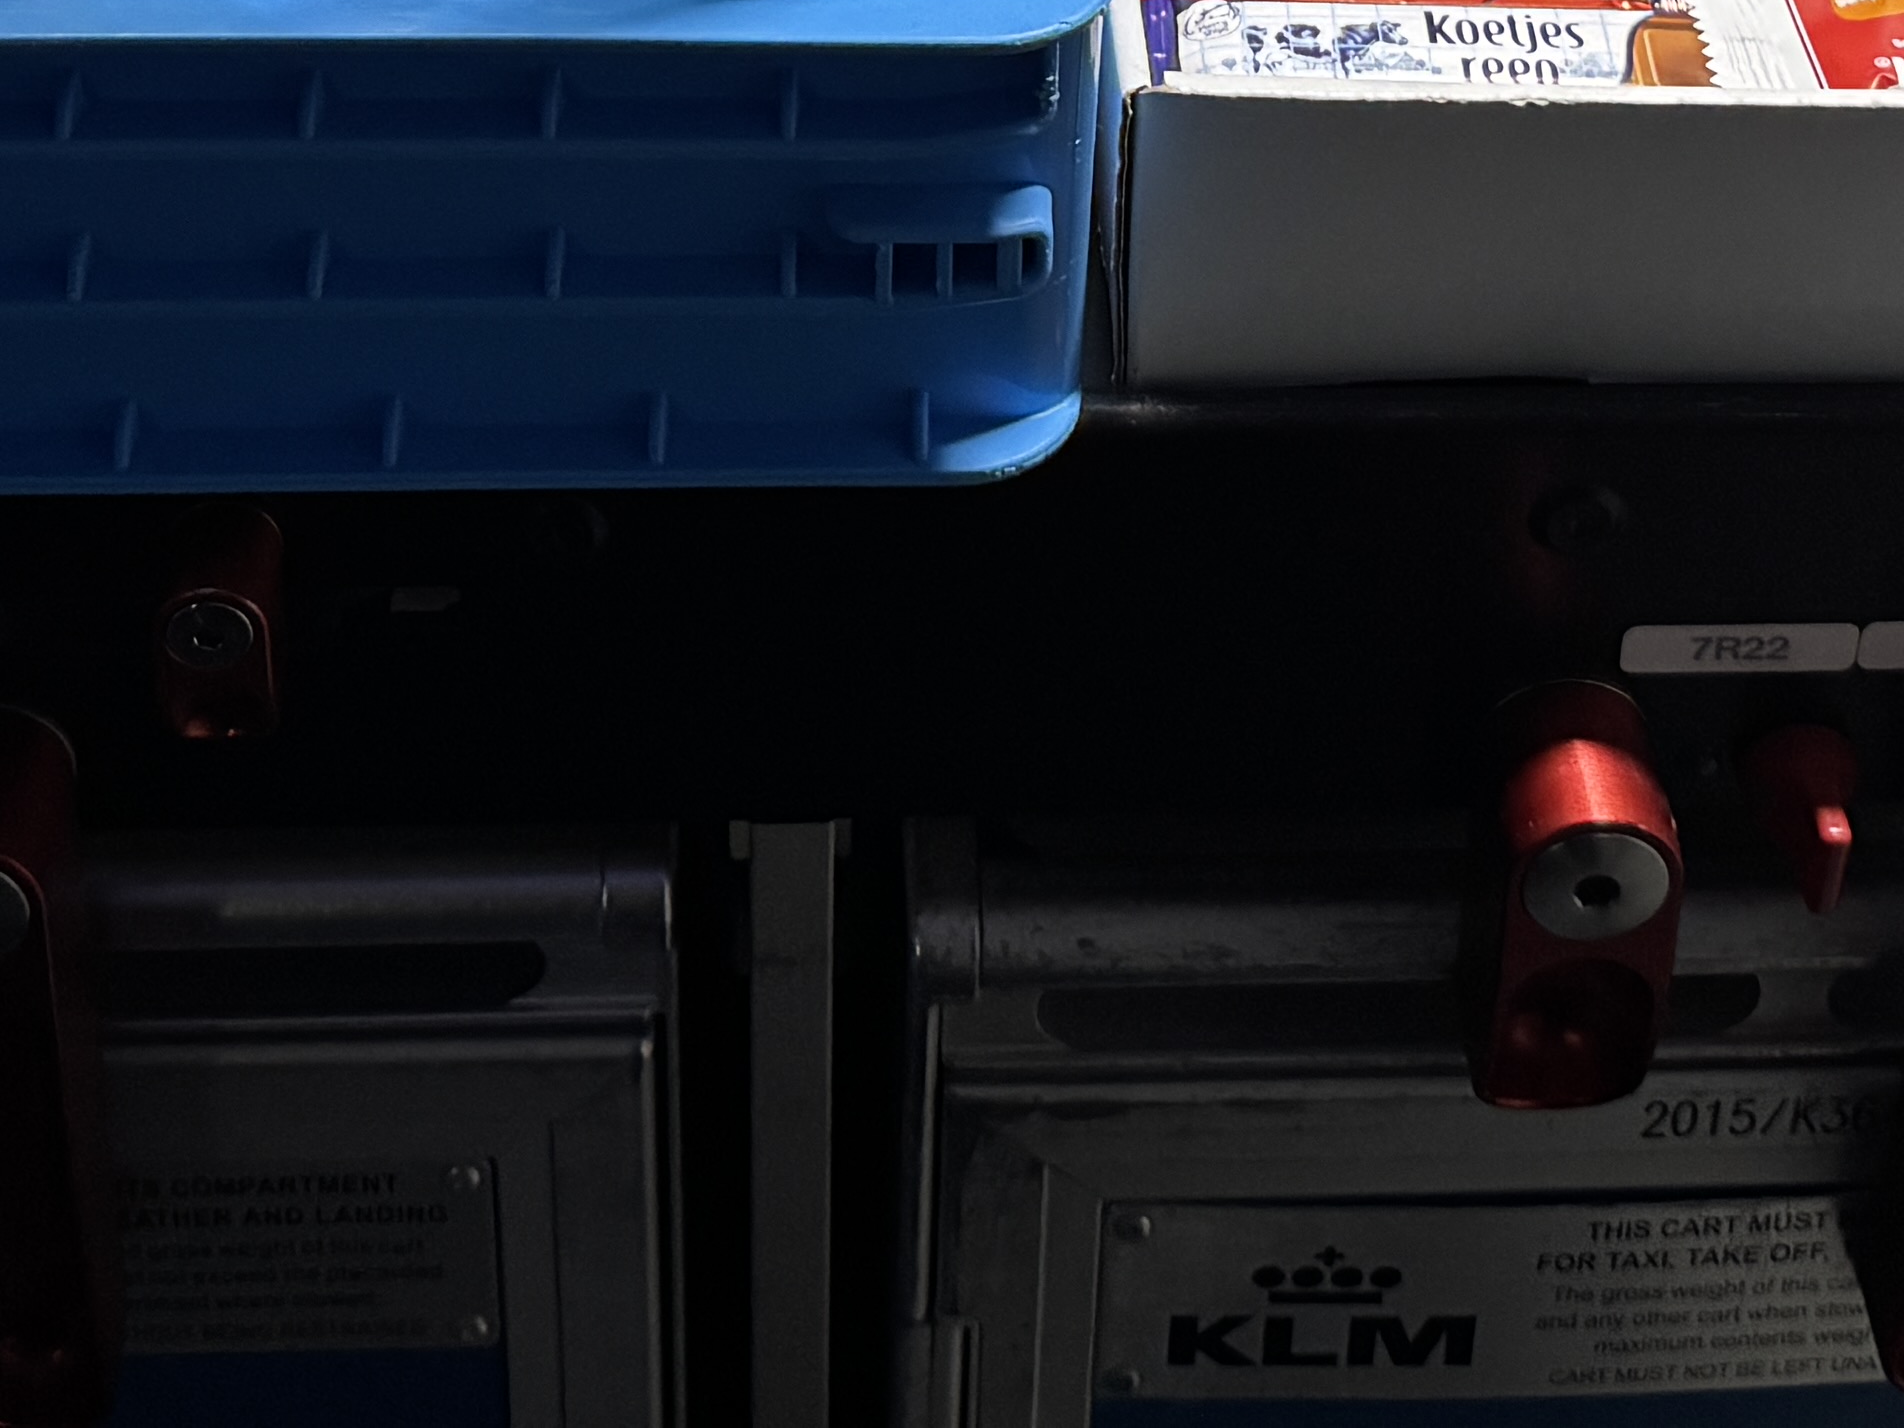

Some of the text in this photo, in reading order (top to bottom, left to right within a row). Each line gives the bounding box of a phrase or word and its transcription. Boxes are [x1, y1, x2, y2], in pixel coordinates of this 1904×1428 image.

[1423, 9, 1586, 53] Koetjes
[1689, 634, 1791, 662] 7R22
[1588, 1210, 1830, 1241] THIS CART MUST
[1536, 1244, 1760, 1272] FOR TAKE
[1167, 1314, 1477, 1368] KLM
